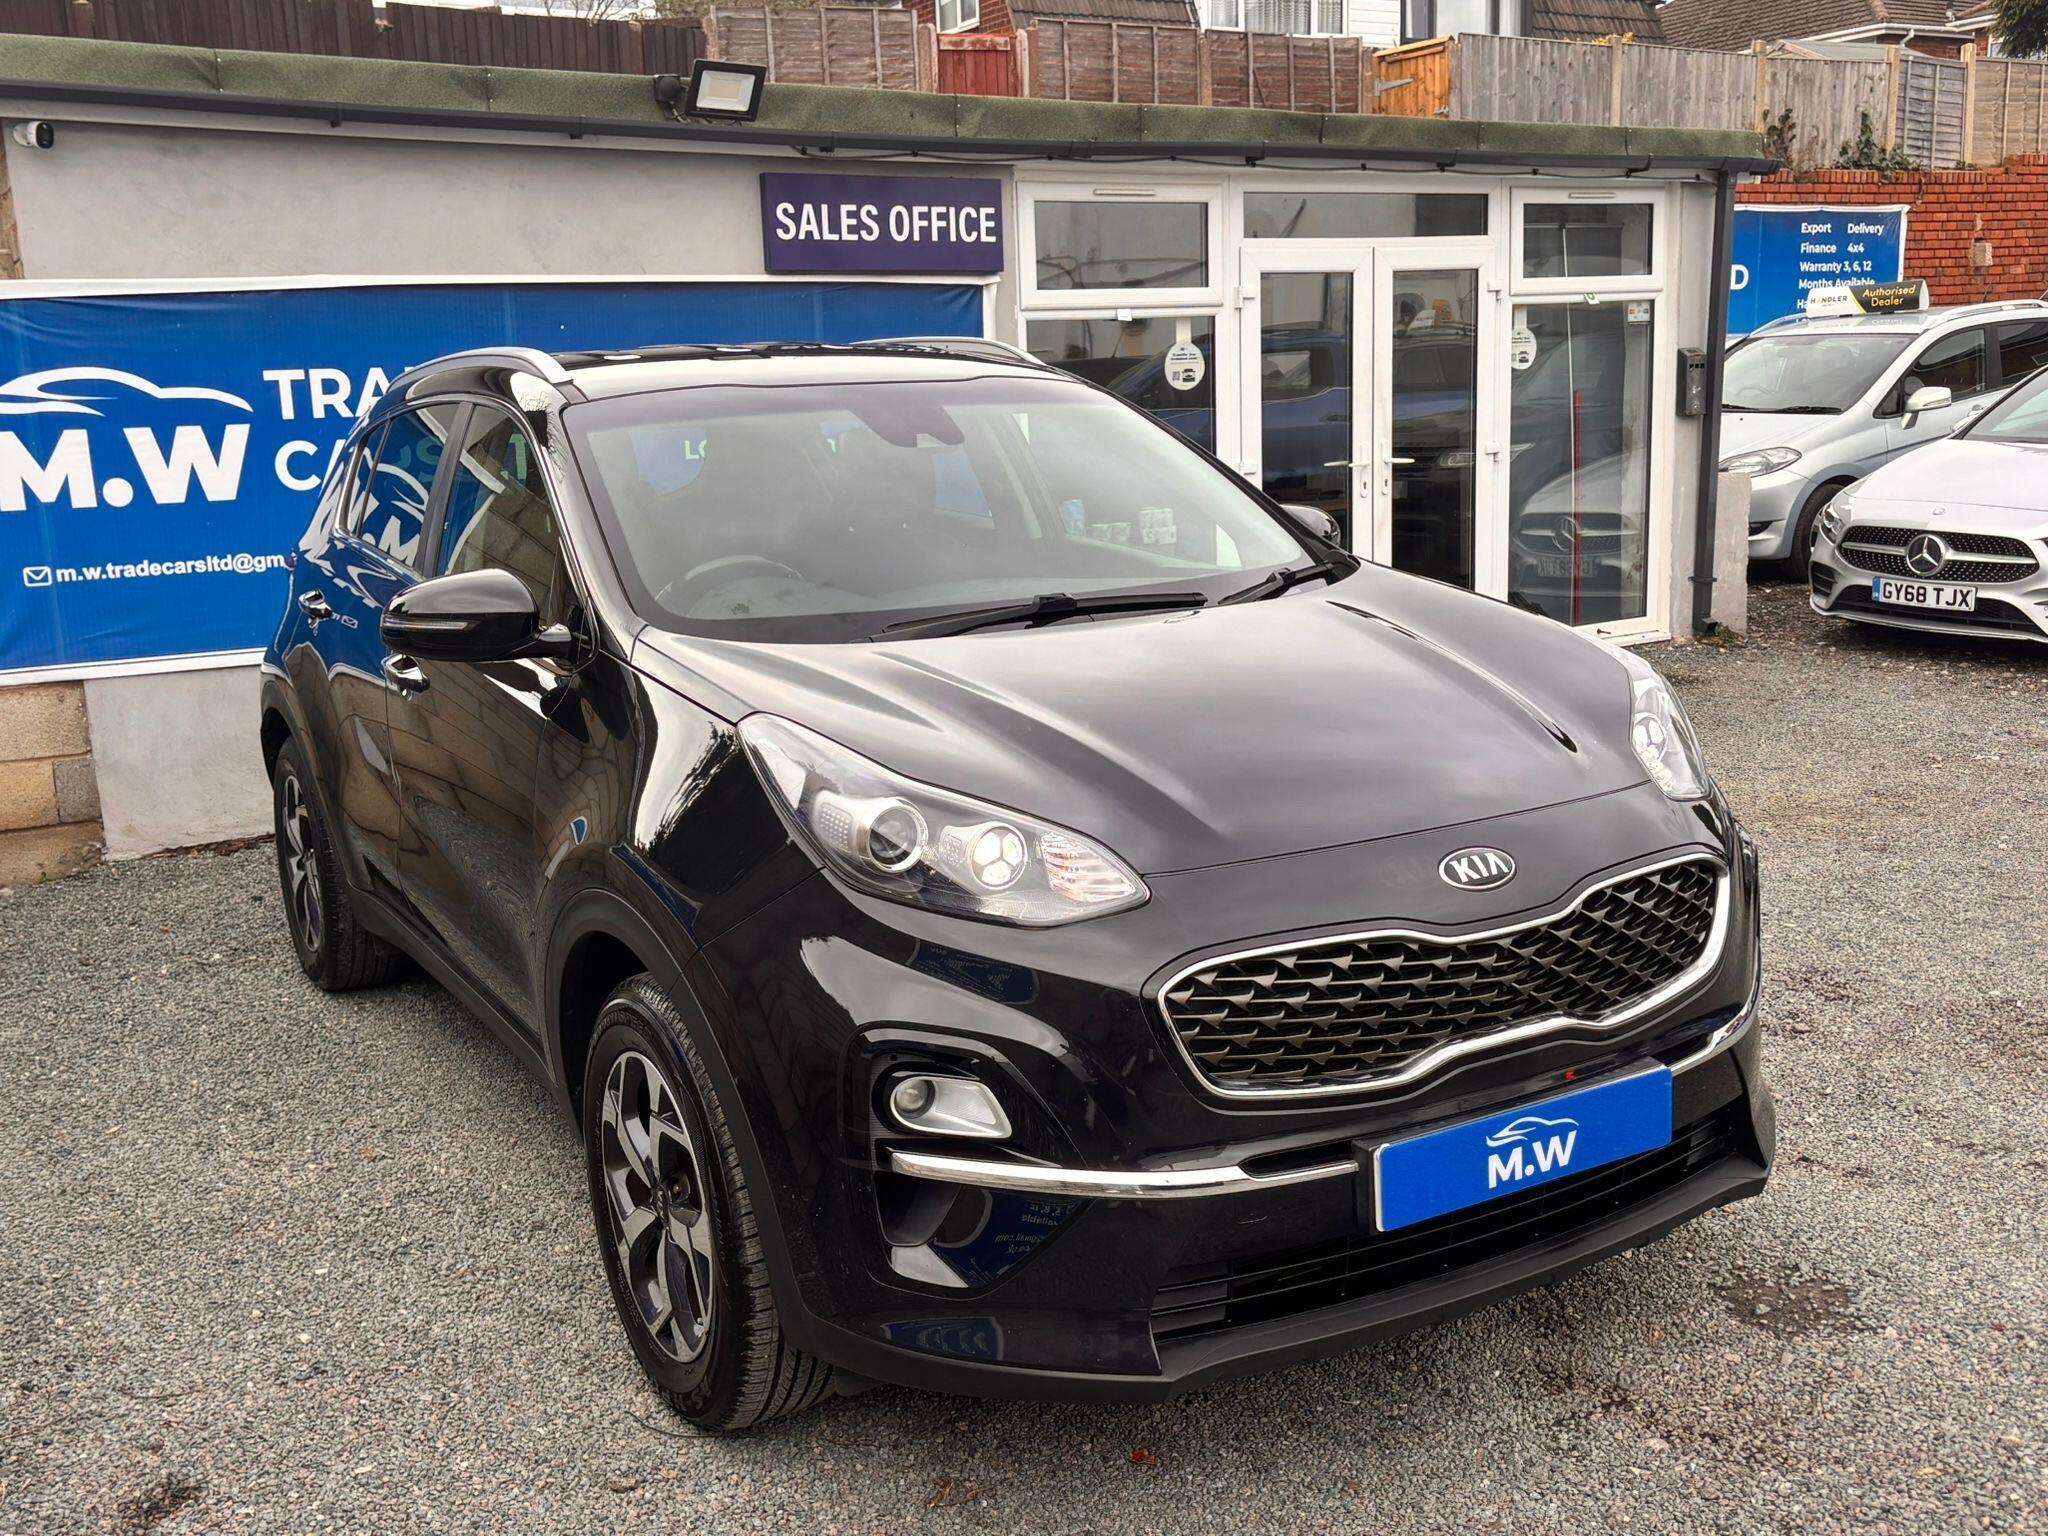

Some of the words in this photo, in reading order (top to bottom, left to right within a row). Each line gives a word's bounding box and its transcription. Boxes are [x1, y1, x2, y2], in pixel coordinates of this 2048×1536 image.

[775, 202, 880, 242] SALES
[889, 204, 997, 242] OFFICE
[1801, 223, 1832, 235] Export
[1847, 223, 1884, 236] Delivery
[1800, 242, 1837, 254] Finance
[1847, 243, 1864, 253] 4x4
[1800, 261, 1842, 273] Warranty
[1863, 261, 1872, 271] 12
[1798, 278, 1832, 289] Months
[1862, 284, 1916, 298] Authorised
[1871, 297, 1904, 307] Dealer
[0, 423, 251, 512] M.W
[56, 552, 285, 583] m.w.tradecarsltd@gm
[1883, 582, 1927, 604] GY68
[1933, 587, 1972, 610] TJX
[1449, 852, 1509, 883] KIA
[1488, 1130, 1578, 1190] M.W
